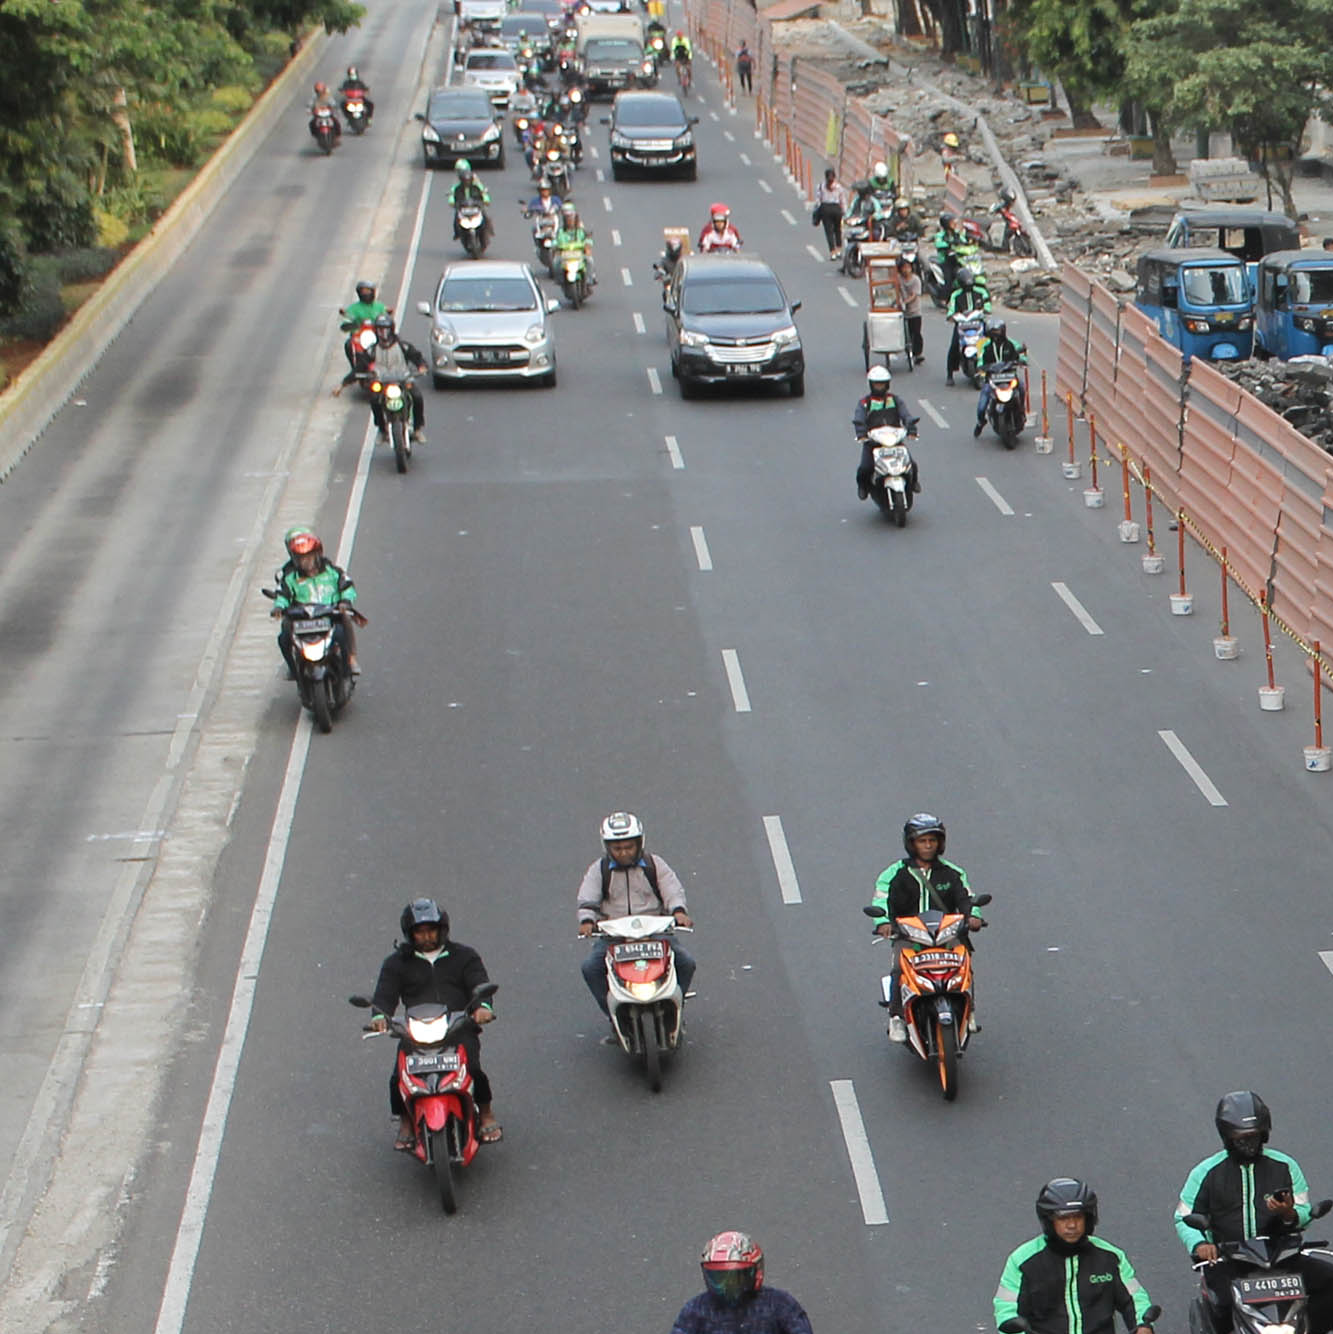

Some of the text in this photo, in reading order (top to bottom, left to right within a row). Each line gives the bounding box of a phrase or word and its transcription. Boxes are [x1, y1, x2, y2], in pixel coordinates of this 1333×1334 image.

[1088, 1271, 1114, 1285] Grab
[1243, 1281, 1251, 1292] B
[1255, 1279, 1278, 1291] 4410
